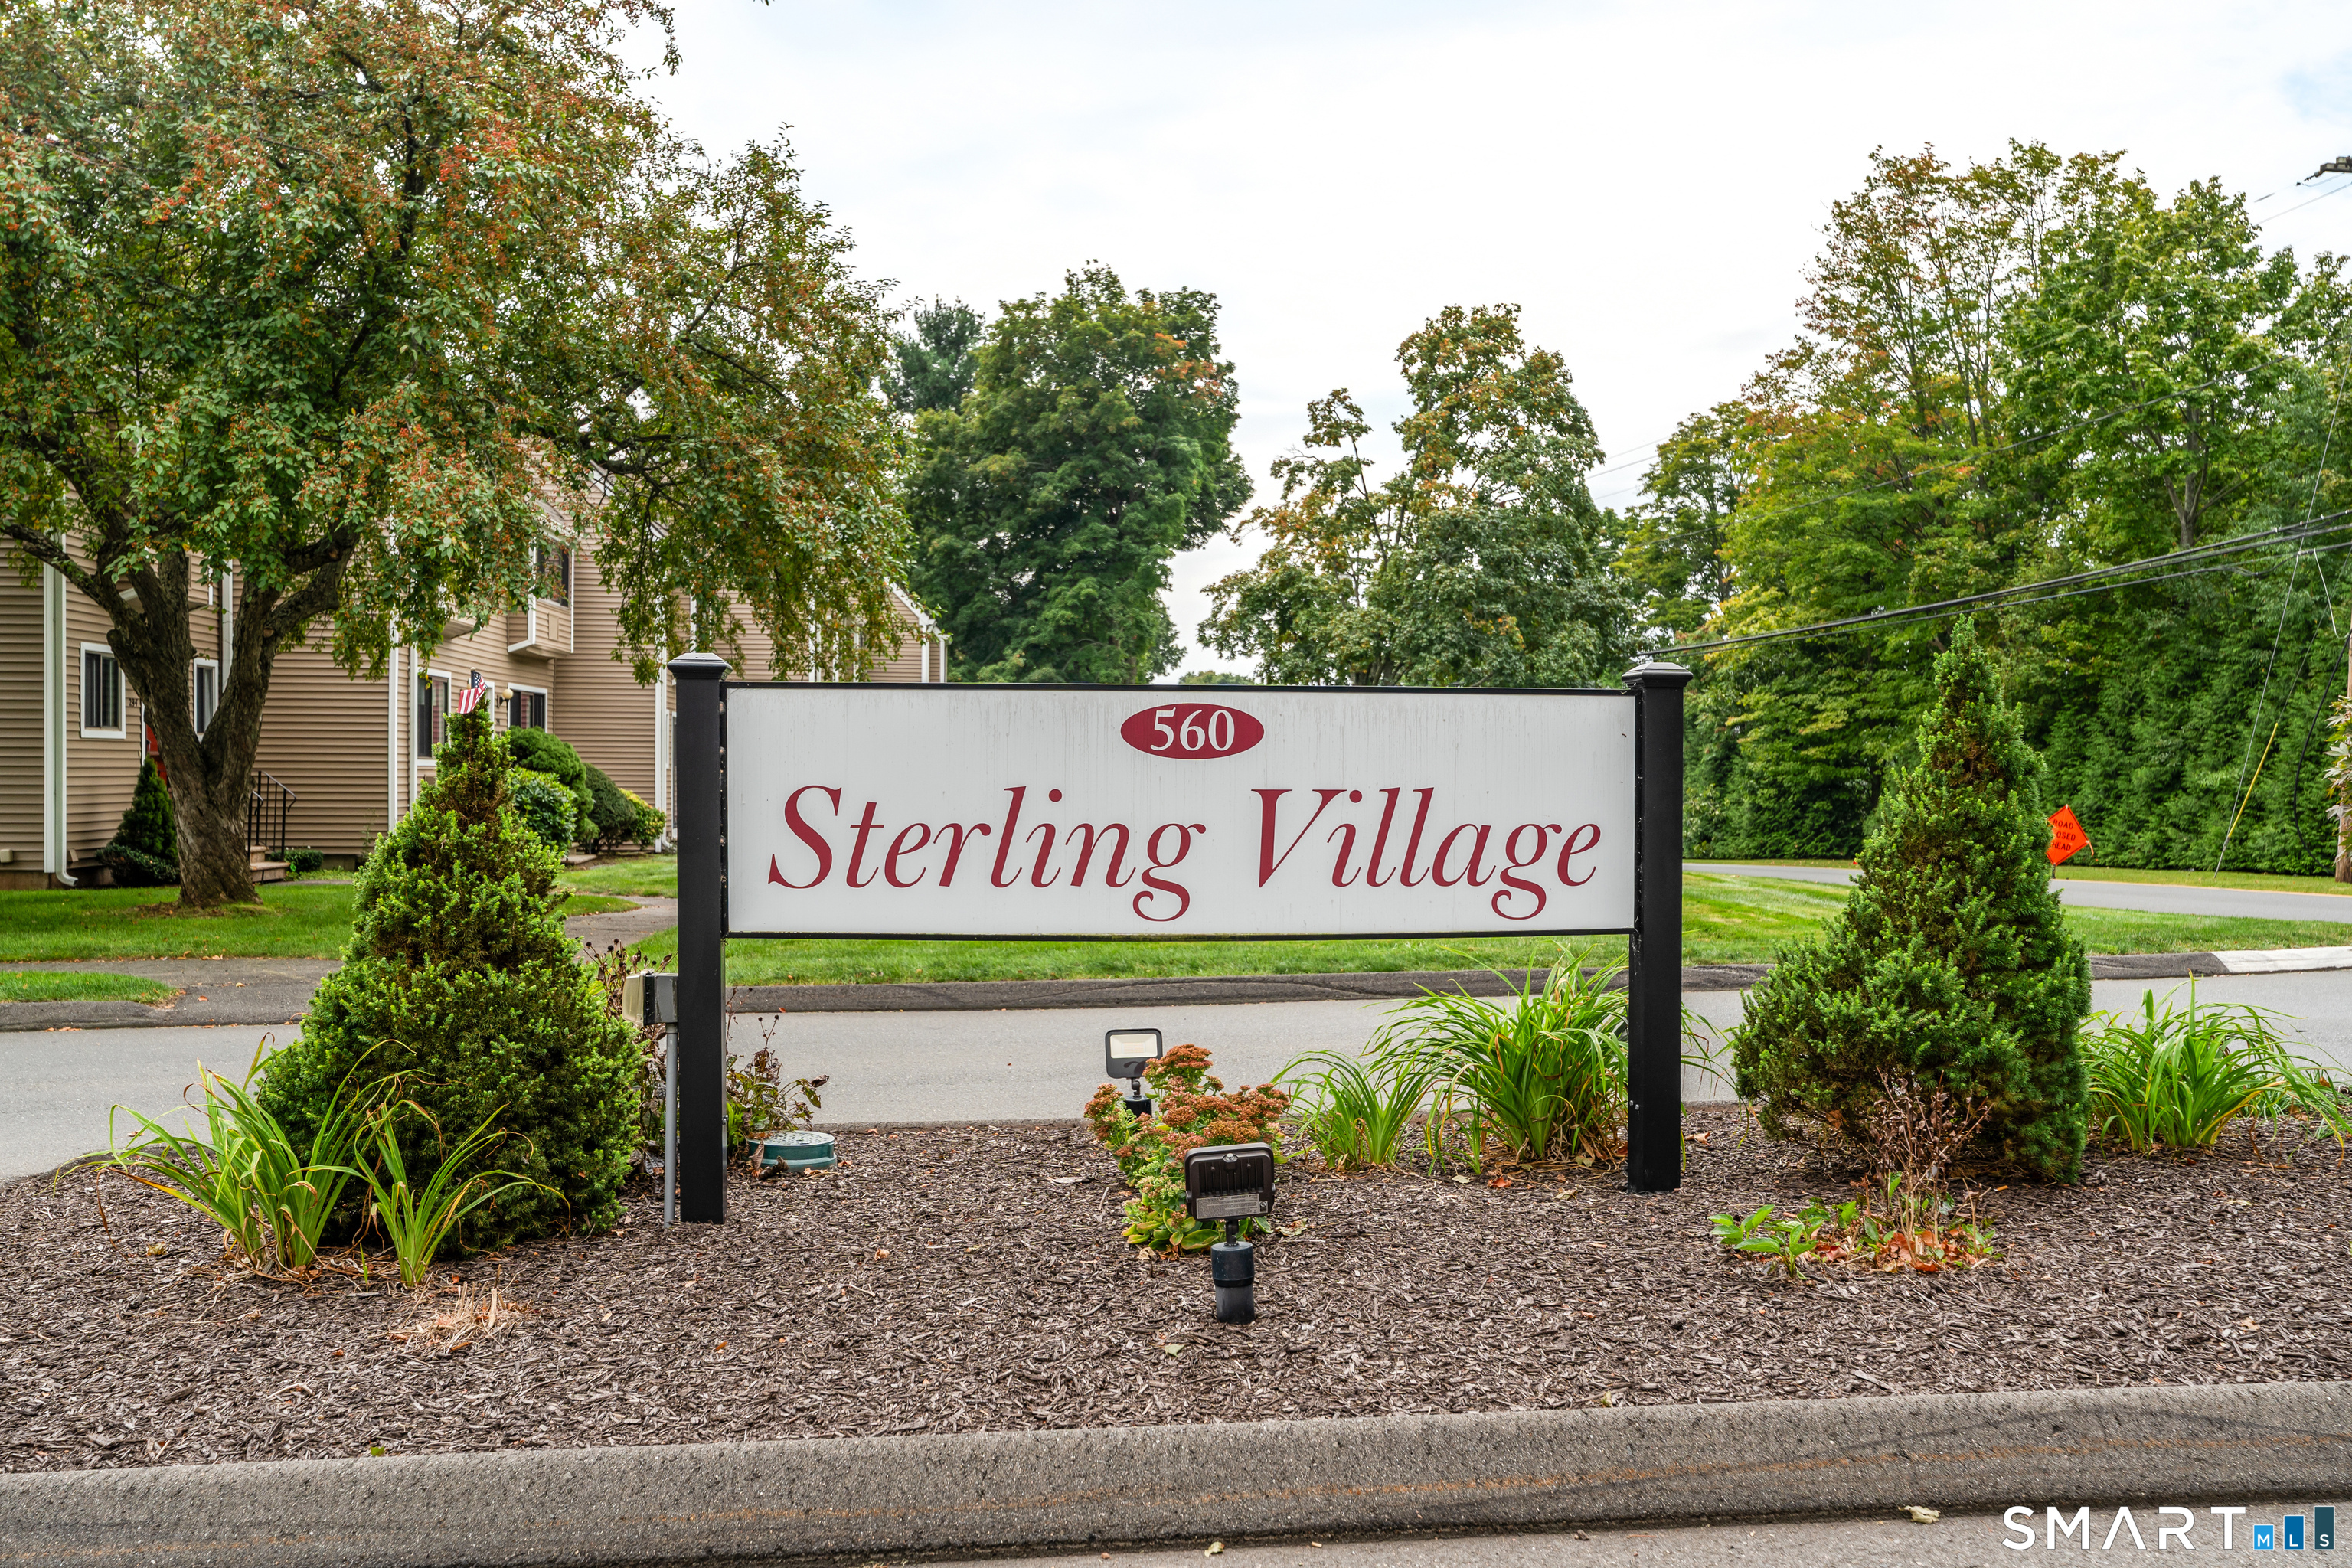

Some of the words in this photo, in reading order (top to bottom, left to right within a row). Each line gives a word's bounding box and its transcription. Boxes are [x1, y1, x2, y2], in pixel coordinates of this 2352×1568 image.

[1150, 707, 1235, 751] 560
[2053, 819, 2073, 829] ROAD
[2056, 831, 2076, 841] OSED
[2052, 841, 2071, 851] HEAD
[769, 785, 1206, 920] Sterling
[1253, 787, 1601, 920] Village
